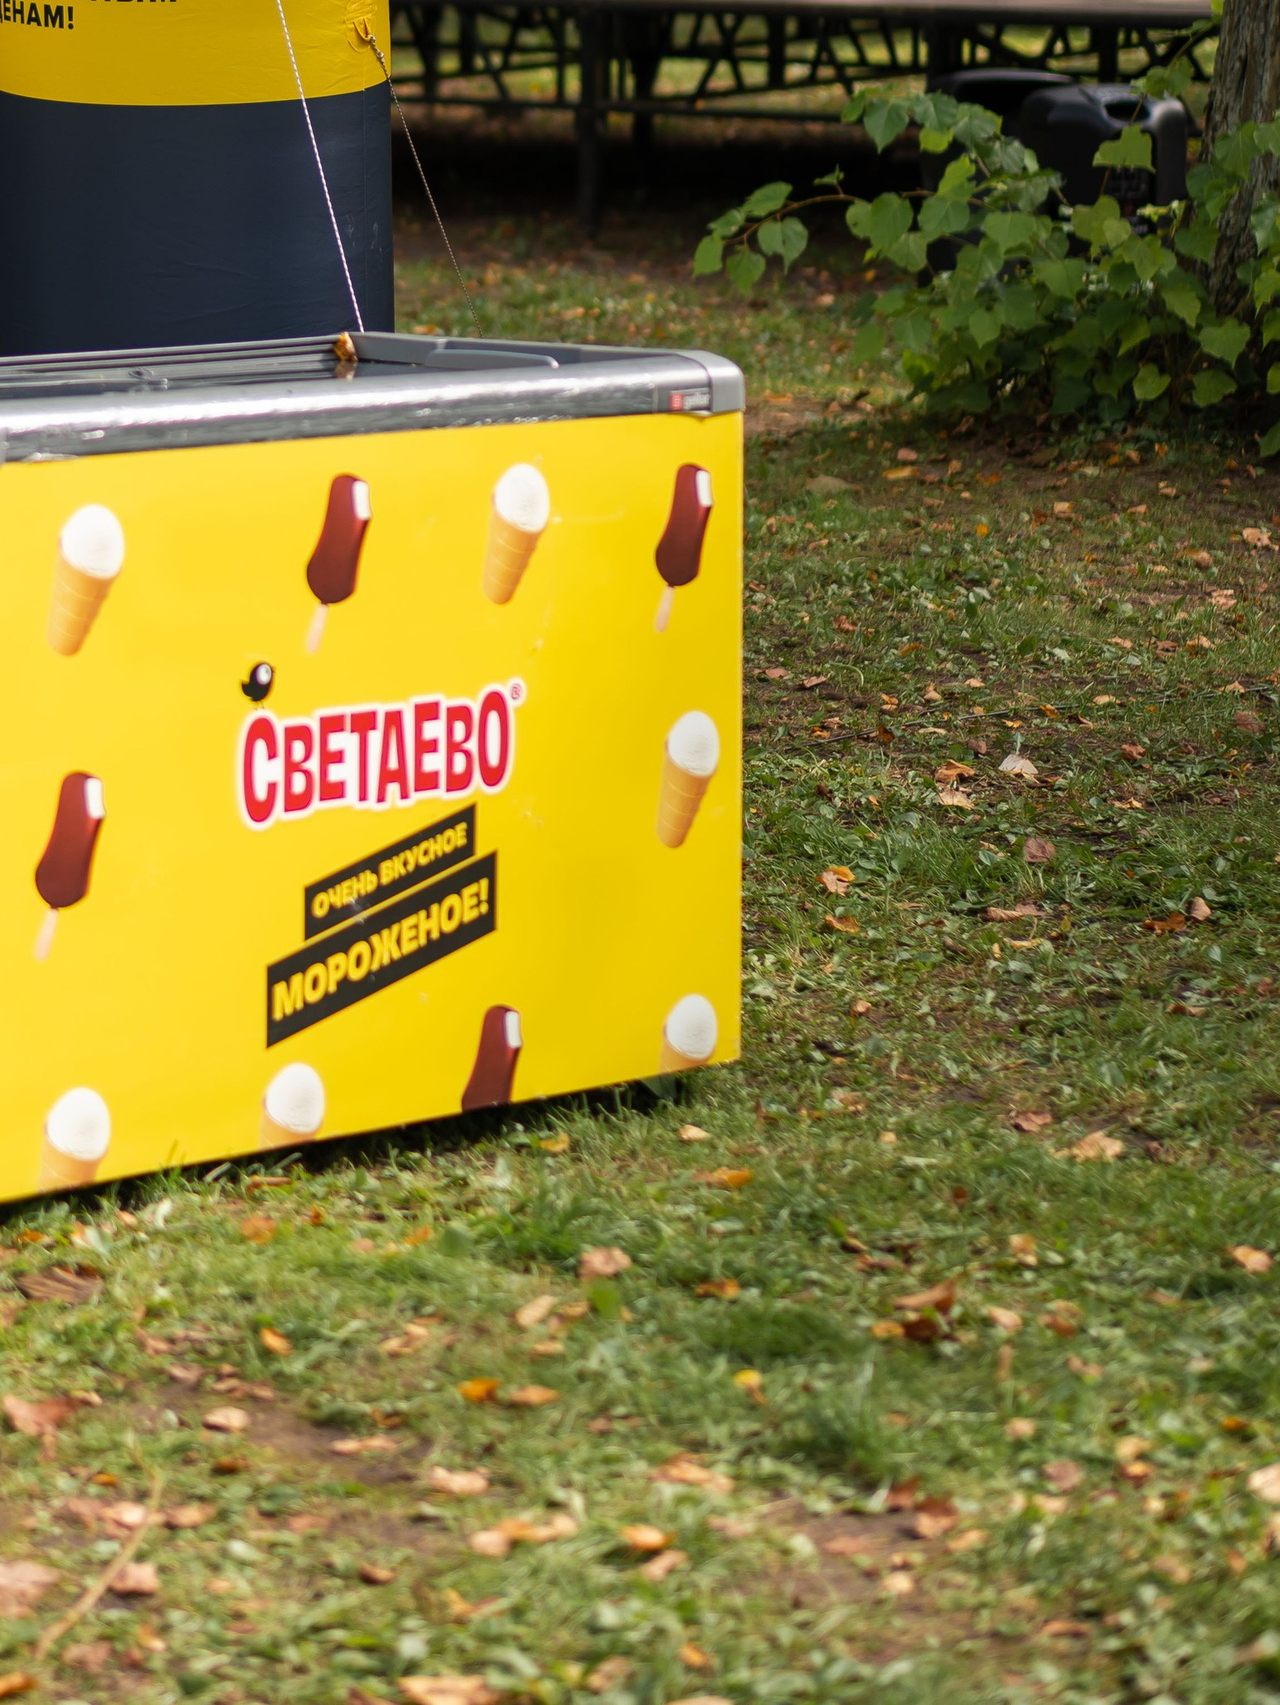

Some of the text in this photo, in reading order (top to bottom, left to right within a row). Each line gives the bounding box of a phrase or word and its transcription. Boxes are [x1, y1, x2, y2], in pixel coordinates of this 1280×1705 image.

[243, 691, 509, 822] СВЕТАЕВО
[312, 822, 468, 918] ОЧЕНЬ ВКУСНОЕ
[271, 877, 490, 1022] МОРОЖЕНОЕ!
